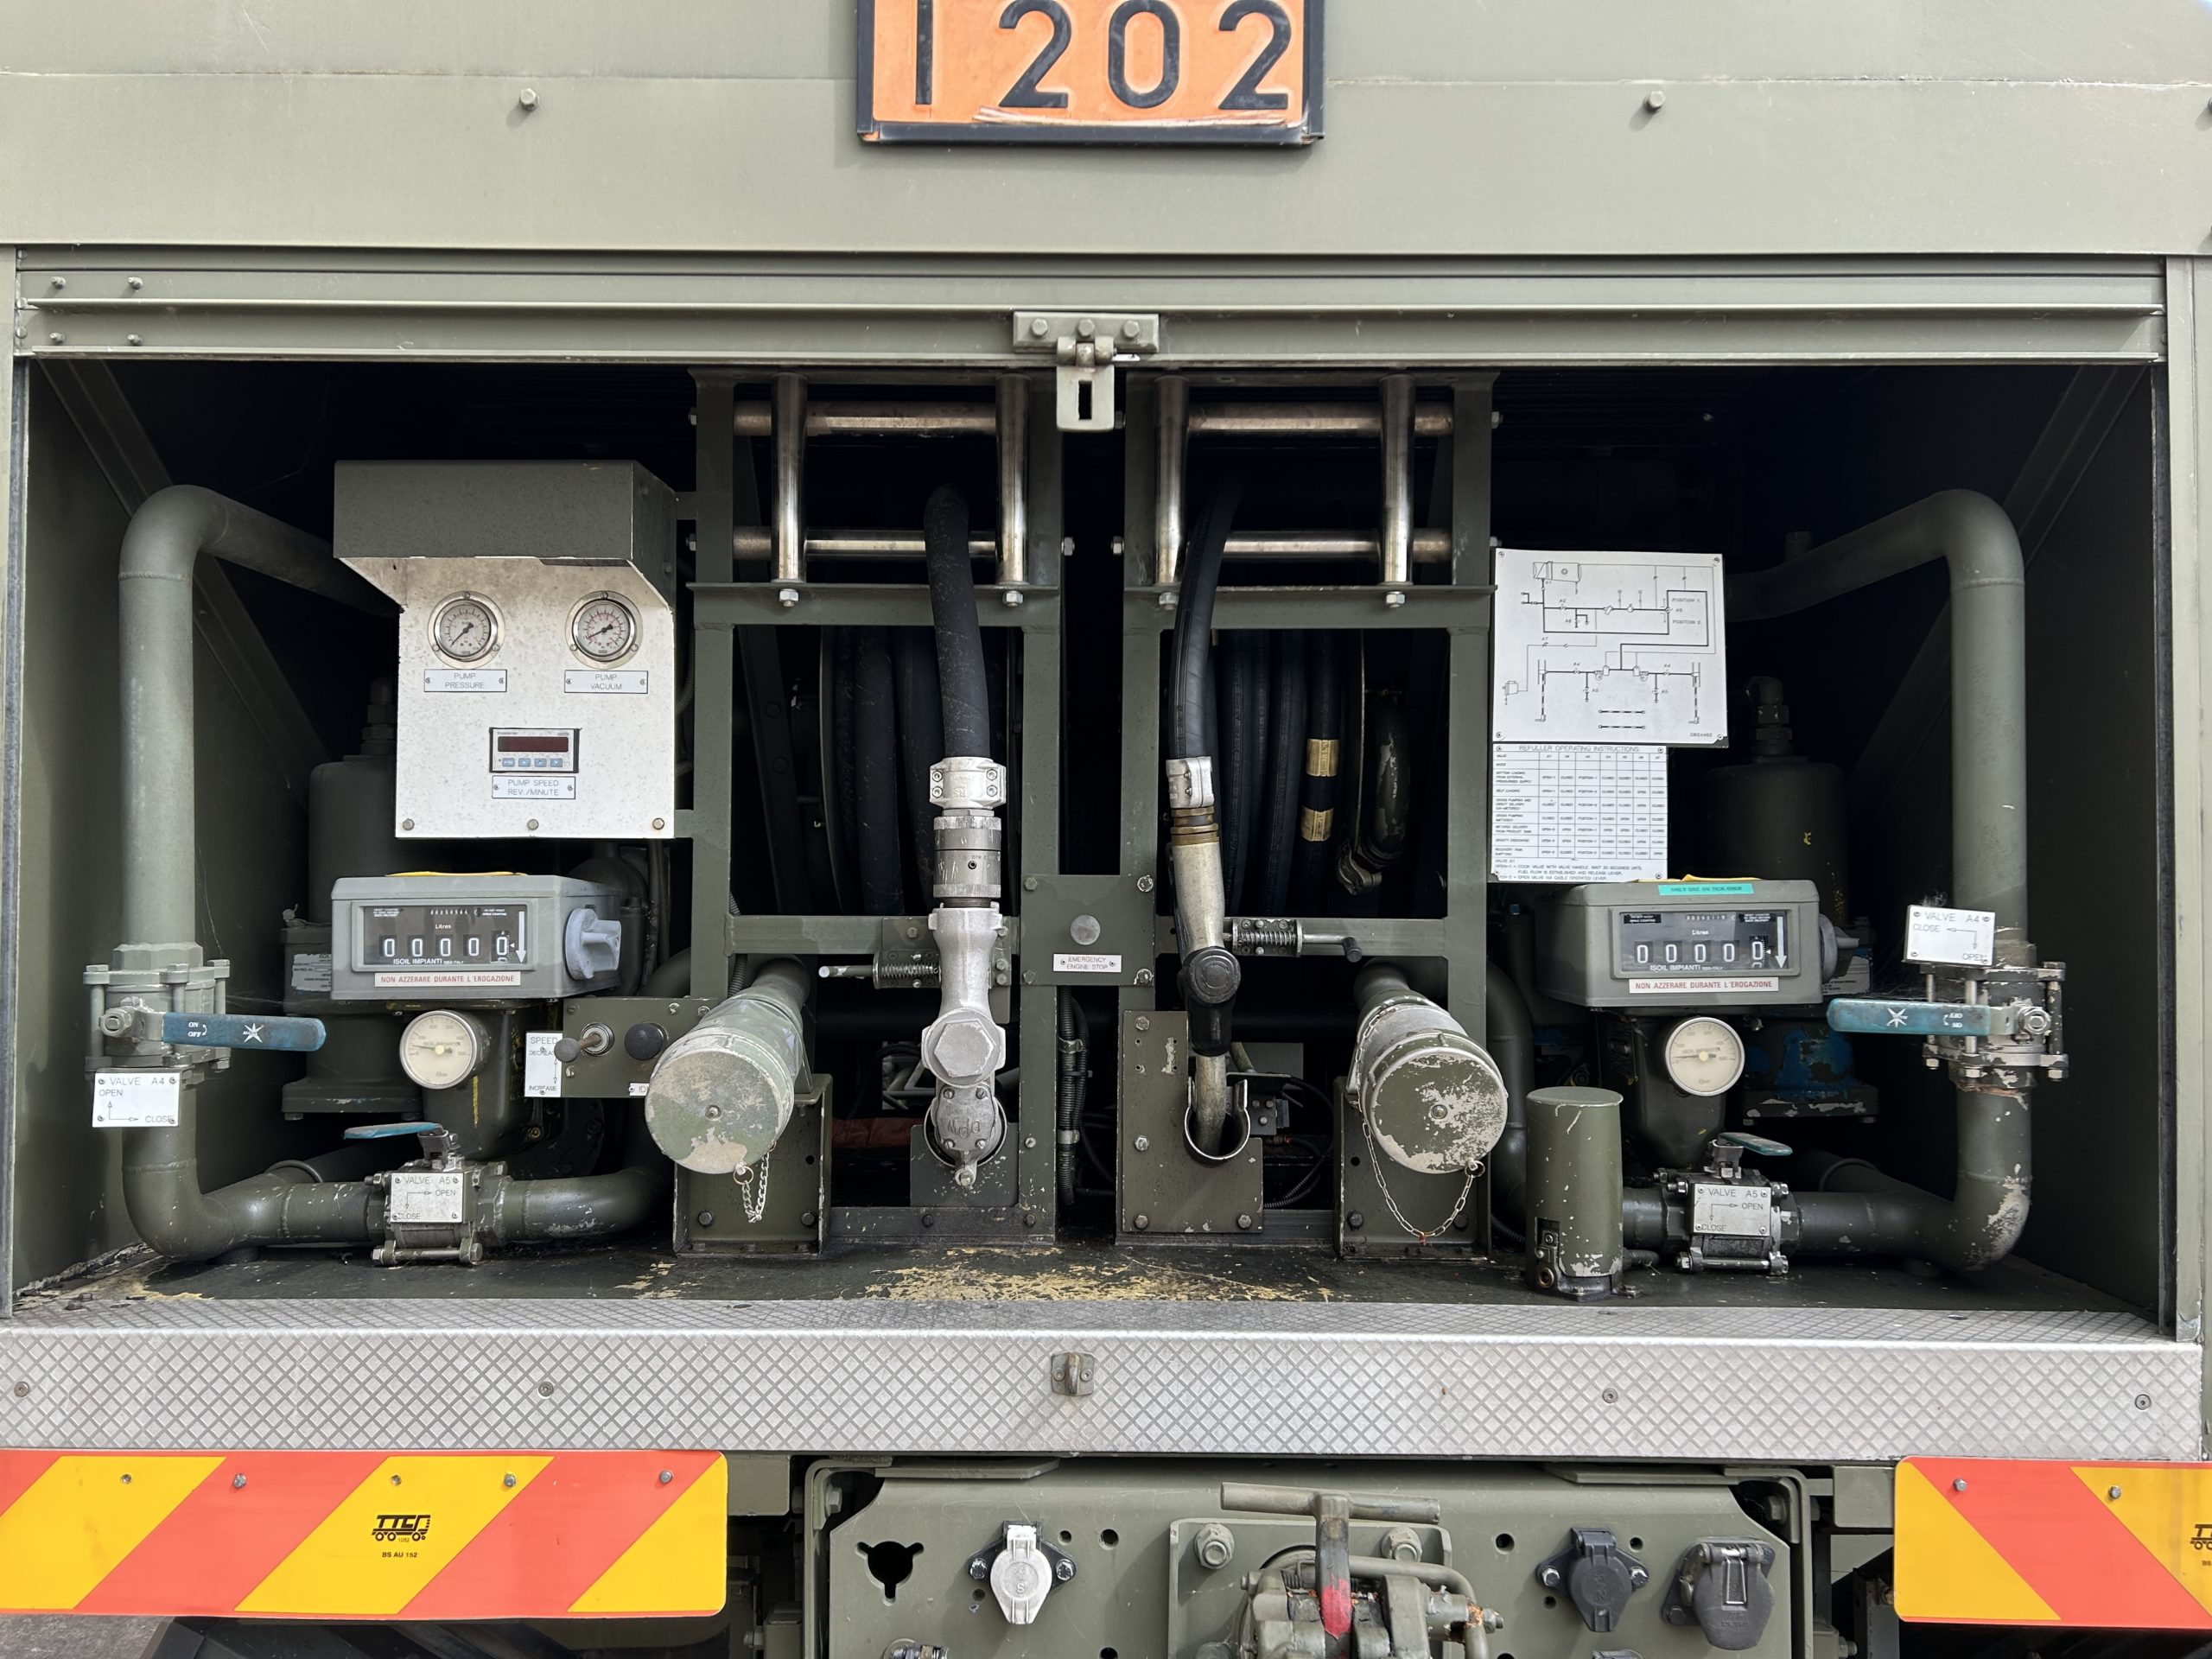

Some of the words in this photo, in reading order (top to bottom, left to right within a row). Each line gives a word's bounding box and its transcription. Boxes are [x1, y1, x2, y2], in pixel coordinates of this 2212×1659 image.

[916, 0, 1292, 110] 1202
[1924, 912, 1955, 922] VALVE
[1966, 914, 1980, 923] A4
[1912, 923, 1941, 933] CLOSE
[110, 1077, 141, 1086] VALVE
[99, 1089, 123, 1097] OPEN
[1707, 1187, 1737, 1198] VALVE
[1745, 1190, 1758, 1198] A5
[1741, 1202, 1764, 1211] OPEN
[1701, 1224, 1726, 1232] CLOSE
